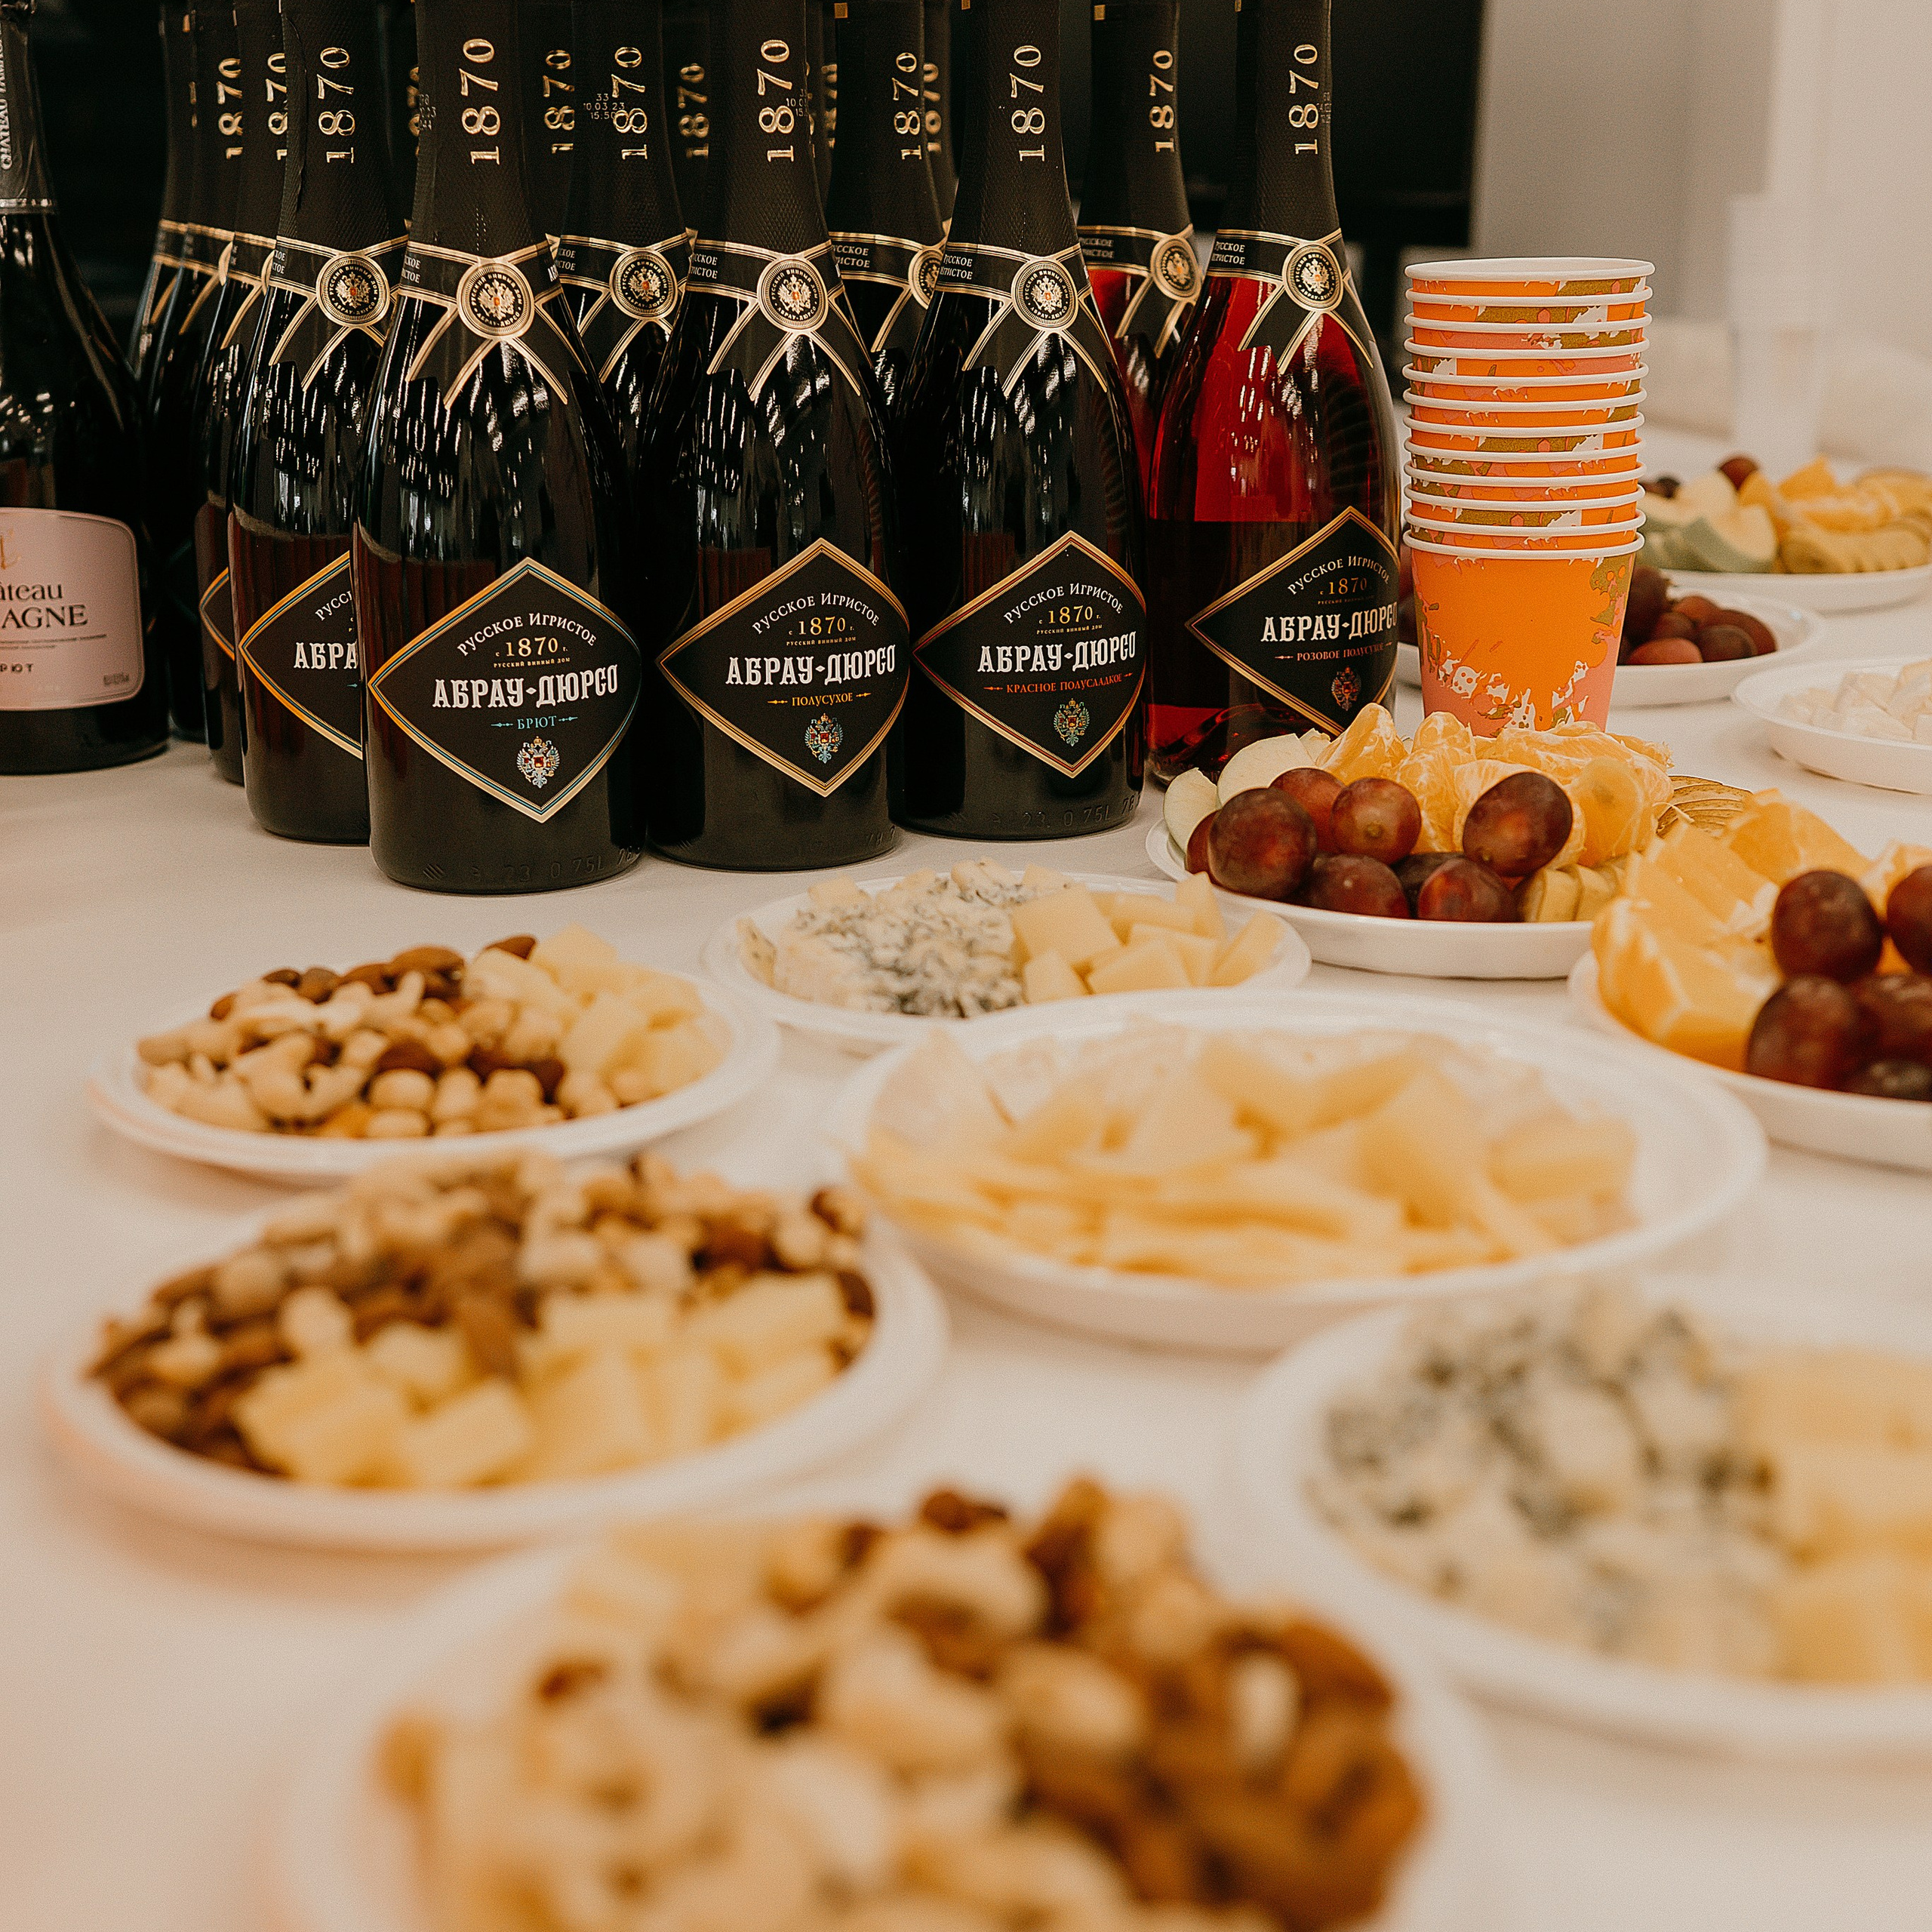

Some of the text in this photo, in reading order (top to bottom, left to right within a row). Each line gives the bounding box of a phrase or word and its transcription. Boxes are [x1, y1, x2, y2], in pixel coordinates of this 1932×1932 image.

[317, 47, 355, 163] 1870
[460, 38, 500, 165] 1870
[543, 50, 575, 154] 1870
[611, 46, 648, 160] 1870
[757, 39, 795, 162] 1870
[892, 52, 922, 161] 1870
[1010, 45, 1045, 162] 1870
[1149, 50, 1174, 152] 1870
[1289, 44, 1318, 155] 1870
[1287, 555, 1390, 595] РУССКОЕ ИГРИСТОЕ
[1328, 577, 1367, 595] 1870
[752, 592, 880, 635] РУССКОЕ ИГРИСТОЕ
[1003, 583, 1123, 624] РУССКОЕ ИГРИСТОЕ
[1048, 605, 1093, 625] 1870
[1260, 601, 1397, 642] АБРАУ-ДЮРСО
[457, 613, 597, 657] РУССКОЕ ИГРИСТОЕ
[506, 636, 559, 658] 1870
[798, 616, 846, 636] 1870
[725, 644, 896, 686] АБРАУ-ДЮРСО
[977, 631, 1137, 673] АБРАУ-ДЮРСО
[1297, 650, 1341, 661] РОЗОВОЕ
[432, 664, 618, 709] АБРАУ-ДЮРСО
[792, 692, 854, 707] ПОЛУСУХОЕ
[1006, 673, 1123, 694] КРАСНОЕ ПОЛУСЛАДКОЕ
[517, 715, 558, 731] БРЮТ
